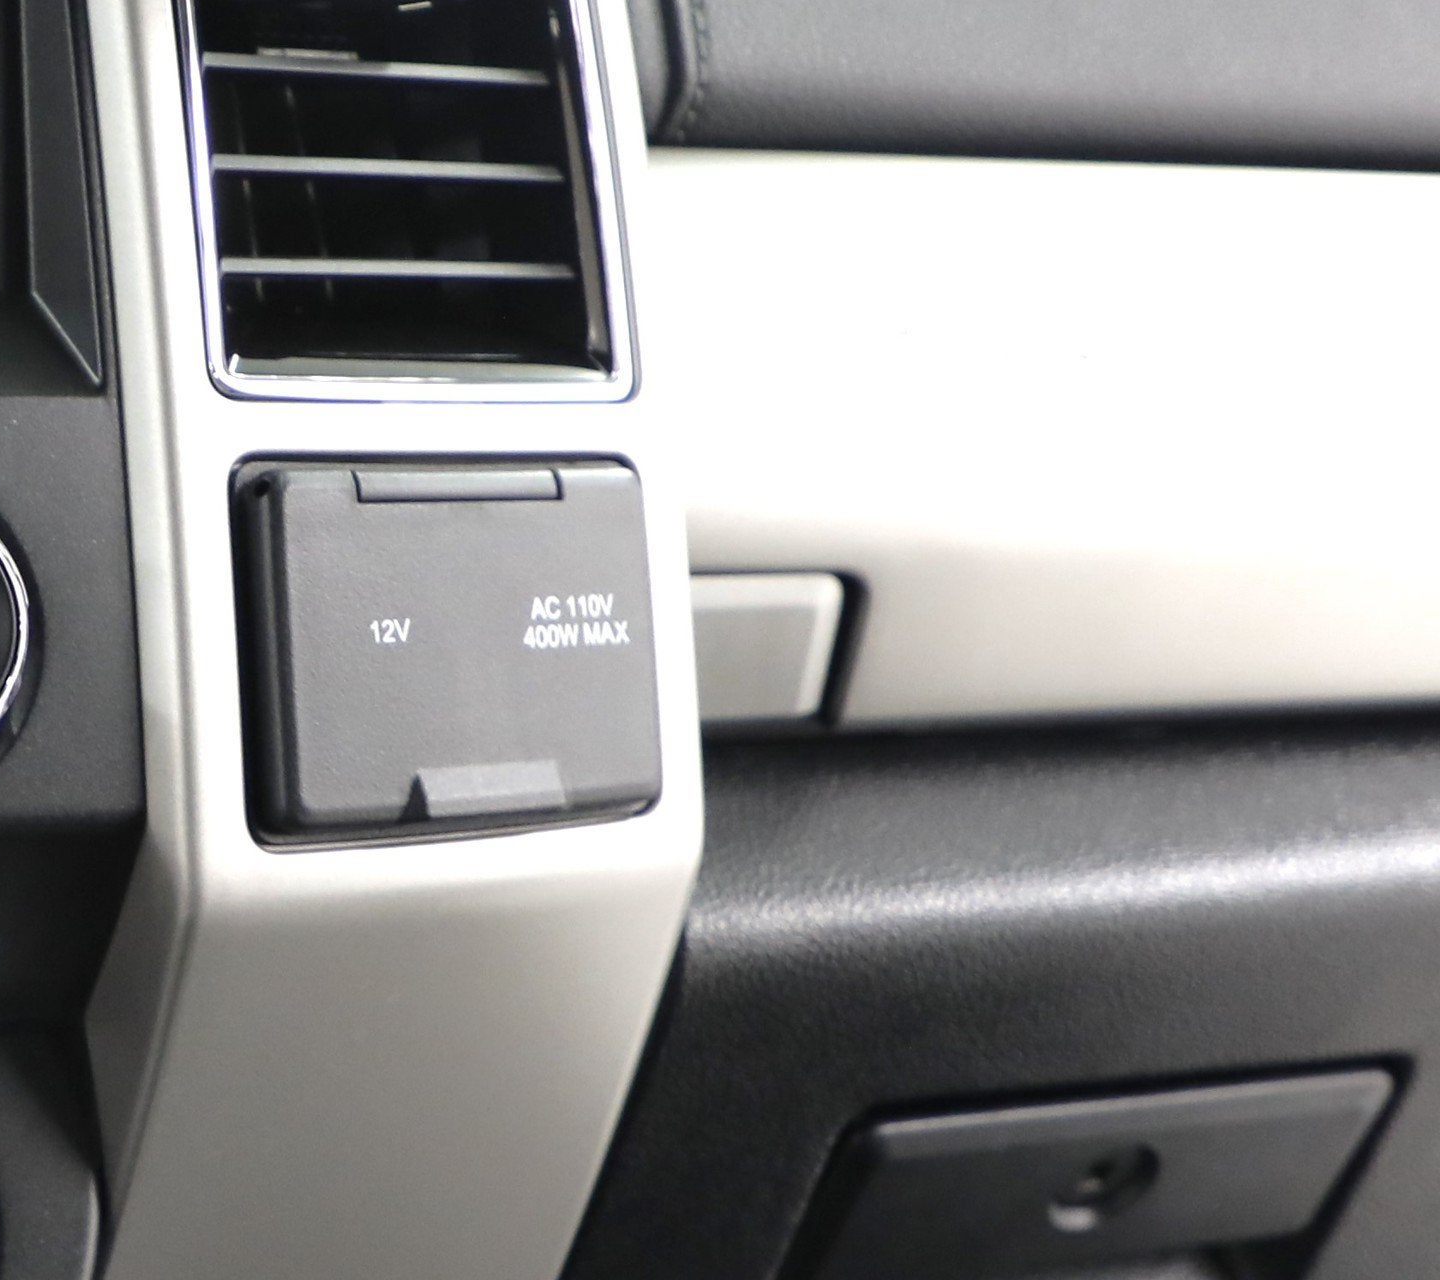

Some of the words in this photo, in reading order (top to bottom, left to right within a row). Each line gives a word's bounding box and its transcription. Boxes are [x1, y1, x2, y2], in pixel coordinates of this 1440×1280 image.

[530, 595, 562, 621] AC
[565, 592, 614, 619] 110V
[369, 617, 411, 644] 12V
[522, 621, 580, 649] 400W
[583, 619, 631, 645] MAX
